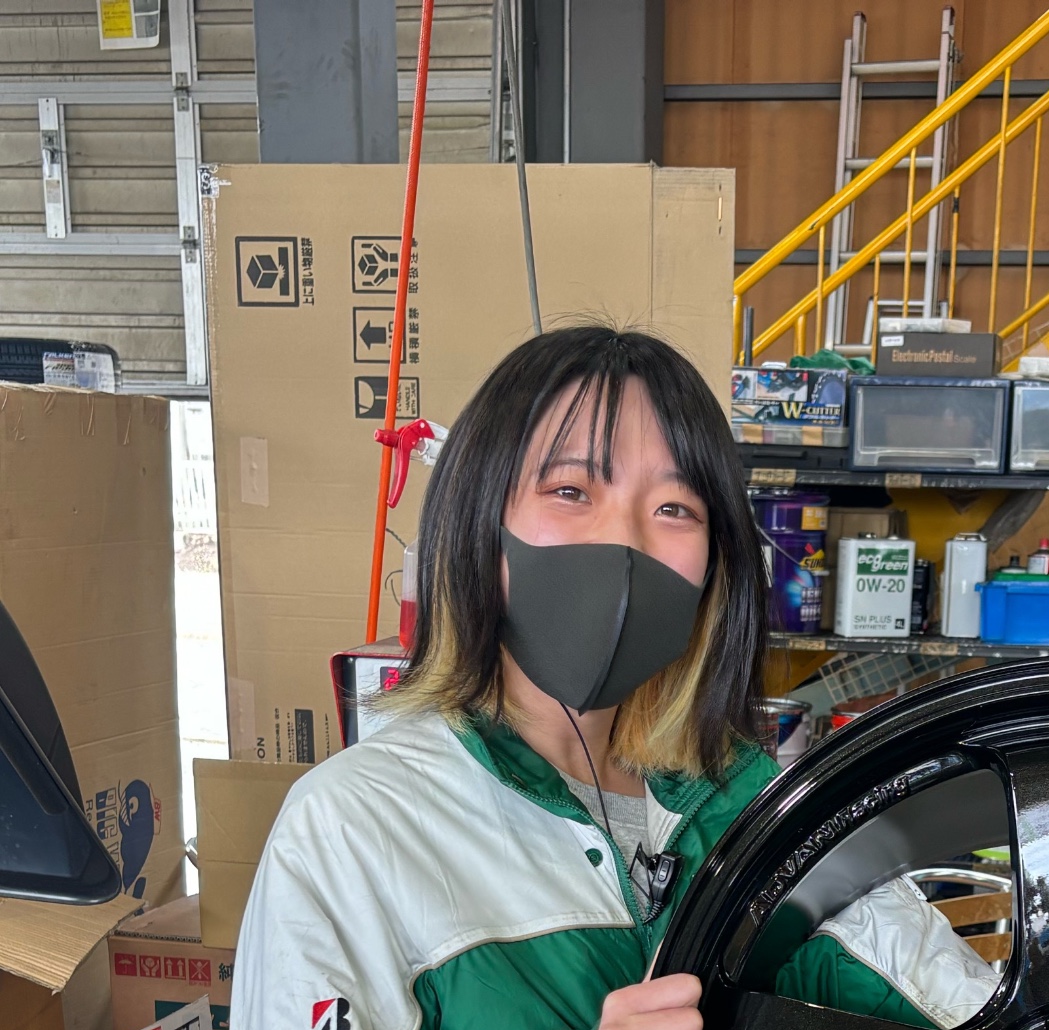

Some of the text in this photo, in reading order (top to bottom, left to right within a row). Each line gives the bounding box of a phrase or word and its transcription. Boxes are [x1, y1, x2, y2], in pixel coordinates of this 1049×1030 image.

[300, 237, 315, 306] 上に重い物厳禁
[856, 578, 905, 593] 0W-20
[854, 615, 892, 624] SN PLUS
